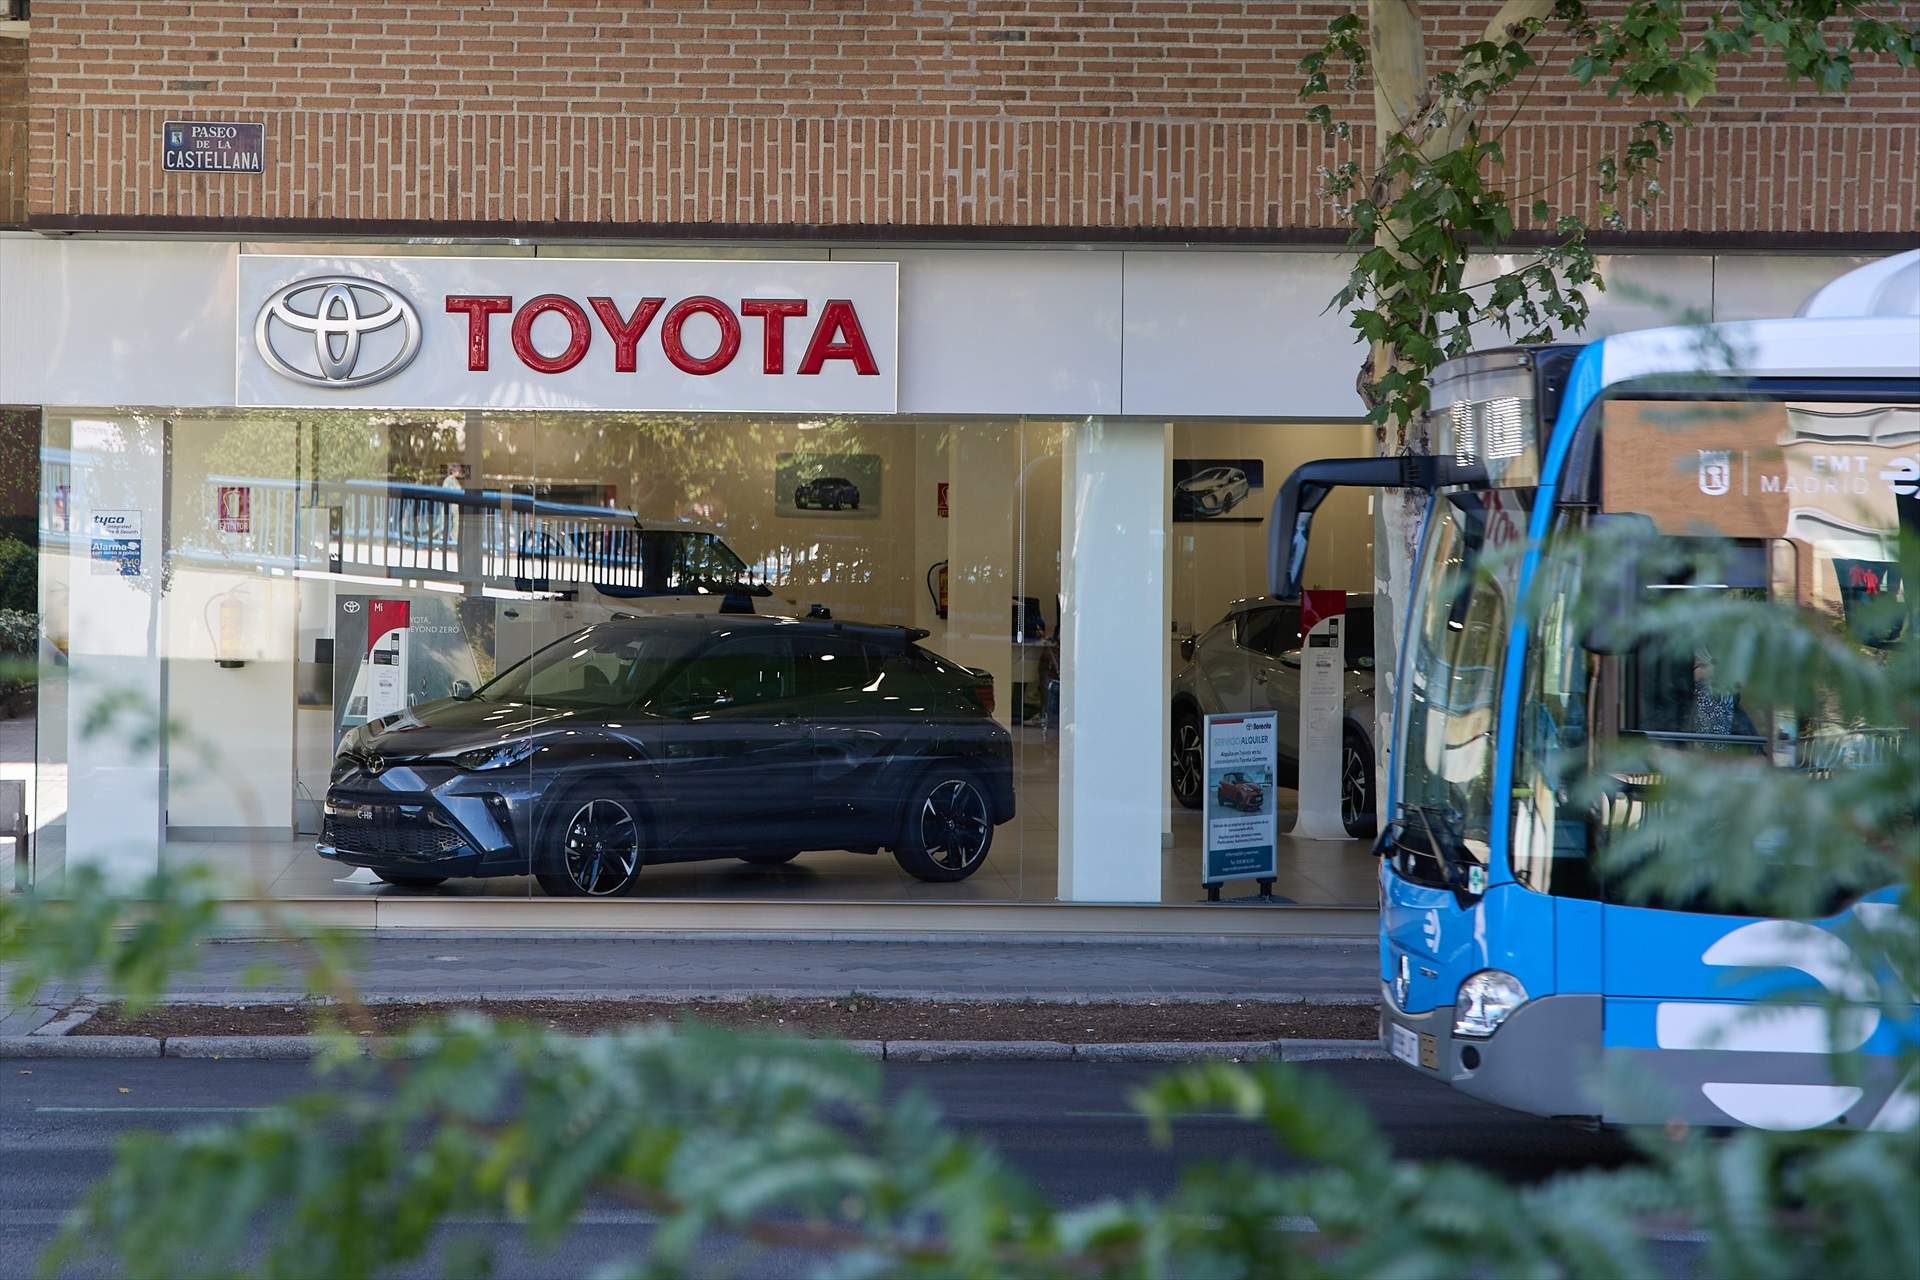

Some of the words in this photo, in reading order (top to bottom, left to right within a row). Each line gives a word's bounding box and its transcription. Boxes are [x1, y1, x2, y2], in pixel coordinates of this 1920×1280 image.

[191, 126, 237, 139] PASEO
[196, 140, 210, 149] DE
[217, 140, 232, 149] LA
[166, 150, 260, 170] CASTELLANA
[445, 293, 881, 376] TOYOTA
[1811, 455, 1870, 473] EMT
[1760, 475, 1870, 495] MADRID
[94, 515, 125, 526] tyco
[92, 542, 127, 551] Alarma
[374, 602, 384, 612] Mi
[439, 625, 460, 634] ZERO
[1240, 735, 1269, 745] ALQUILER
[357, 810, 373, 820] C-HR
